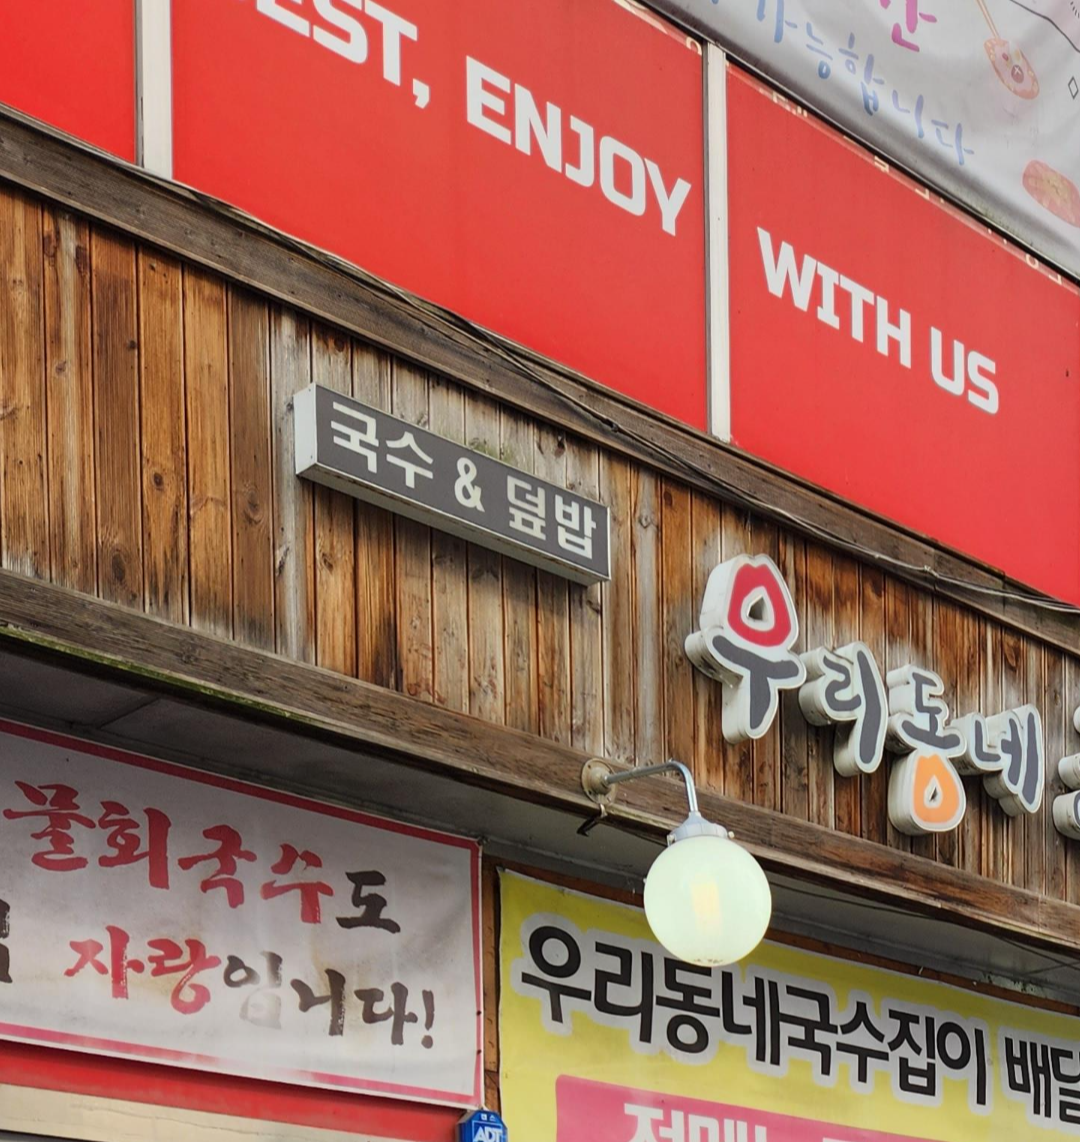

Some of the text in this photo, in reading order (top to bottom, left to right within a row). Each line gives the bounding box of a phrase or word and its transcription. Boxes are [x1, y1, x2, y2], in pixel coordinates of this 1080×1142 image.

[256, 0, 692, 237] ST, ENJOY
[757, 226, 999, 415] WITH US
[331, 401, 596, 561] 국수 & 덮밥
[698, 556, 1043, 833] 우리동네
[3, 781, 401, 934] 물회국수도
[64, 925, 434, 1049] 자랑입니다!
[521, 925, 986, 1106] 우리동네국수집이
